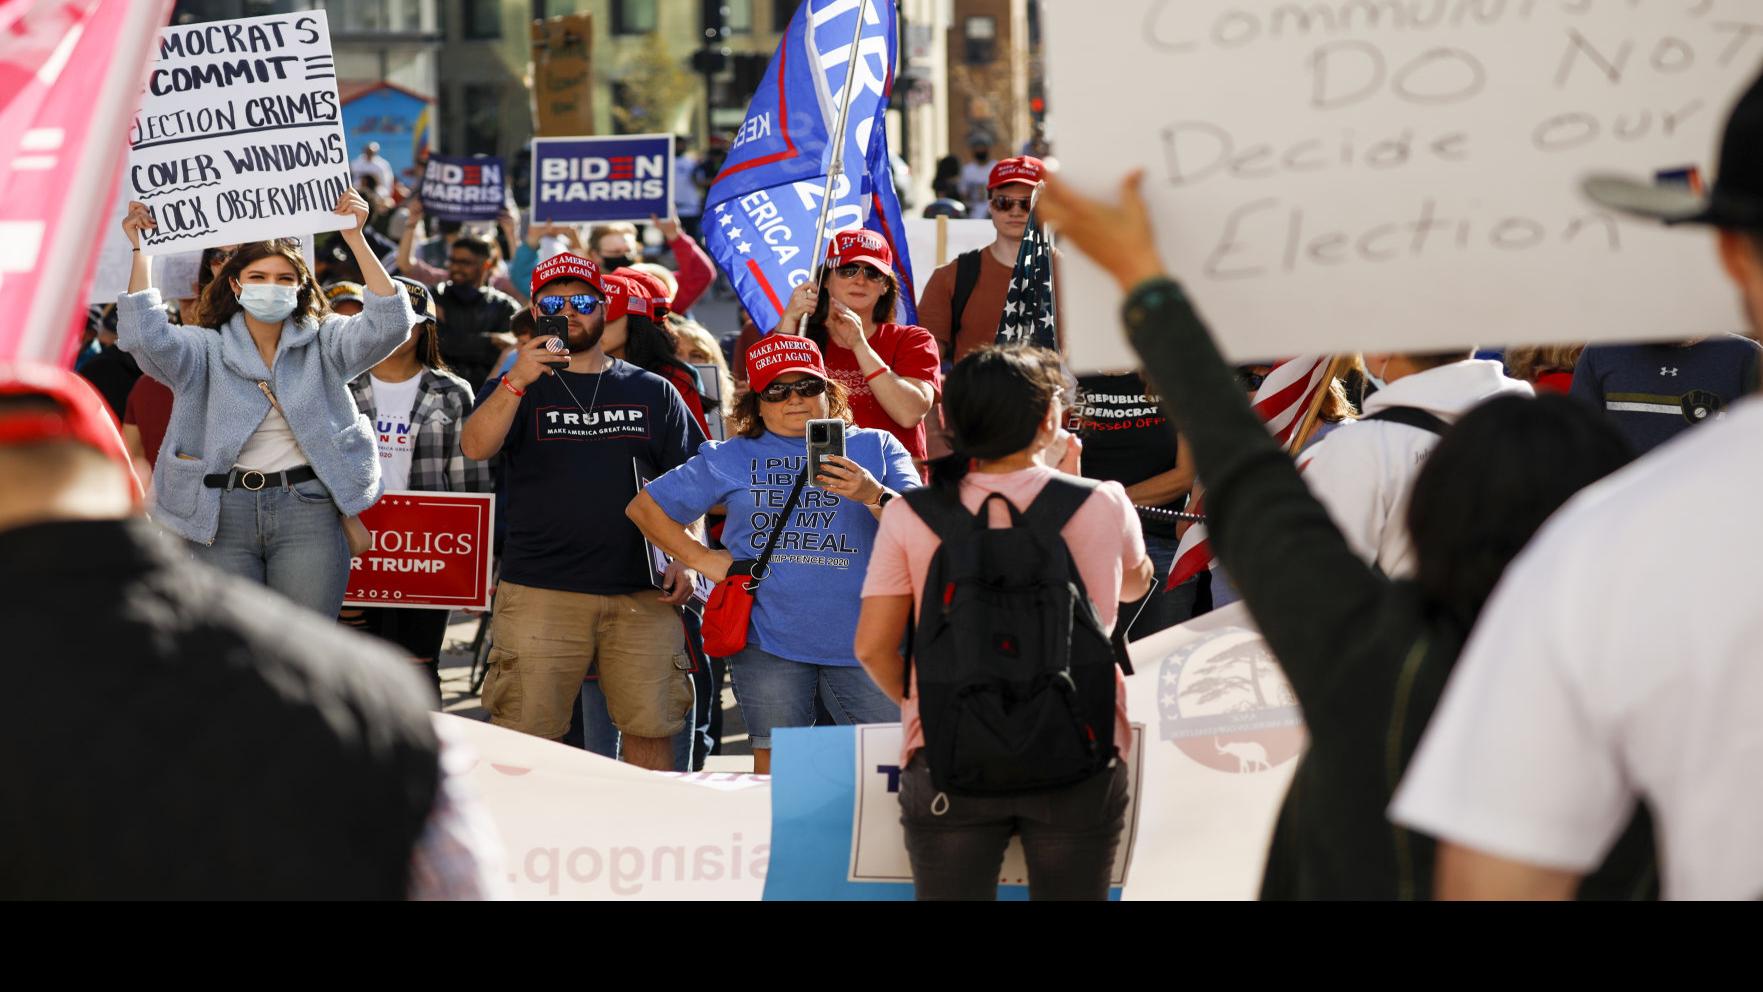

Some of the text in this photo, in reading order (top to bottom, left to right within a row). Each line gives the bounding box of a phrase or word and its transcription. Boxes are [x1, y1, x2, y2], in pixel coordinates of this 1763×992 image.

[158, 17, 319, 60] MOCRATS
[150, 56, 298, 96] COMMIT
[1305, 40, 1488, 107] DO
[245, 90, 338, 127] CRIMES
[1160, 118, 1470, 187] Decide
[131, 133, 344, 194] COVER WINDOWS
[425, 160, 500, 185] BIDEN
[541, 154, 664, 182] BIDEN
[216, 172, 350, 223] OBSERVATION
[421, 180, 503, 203] HARRIS
[541, 180, 664, 202] HARRIS
[738, 189, 801, 266] ERICA
[1203, 196, 1622, 281] Election
[535, 255, 596, 273] MAKE AMERICA
[540, 266, 593, 280] GREAT AGAIN
[406, 284, 425, 297] RICA
[750, 340, 816, 360] MAKE AMERICA
[755, 352, 812, 370] GREAT AGAIN
[546, 409, 643, 426] TRUMP
[1085, 407, 1159, 418] DEMOCRAT
[567, 428, 598, 436] AMERICA
[598, 426, 621, 434] GREAT
[751, 458, 758, 473] I
[795, 511, 837, 529] MY
[368, 557, 446, 573] TRUMP
[827, 557, 850, 567] 2020
[357, 589, 402, 599] 2020
